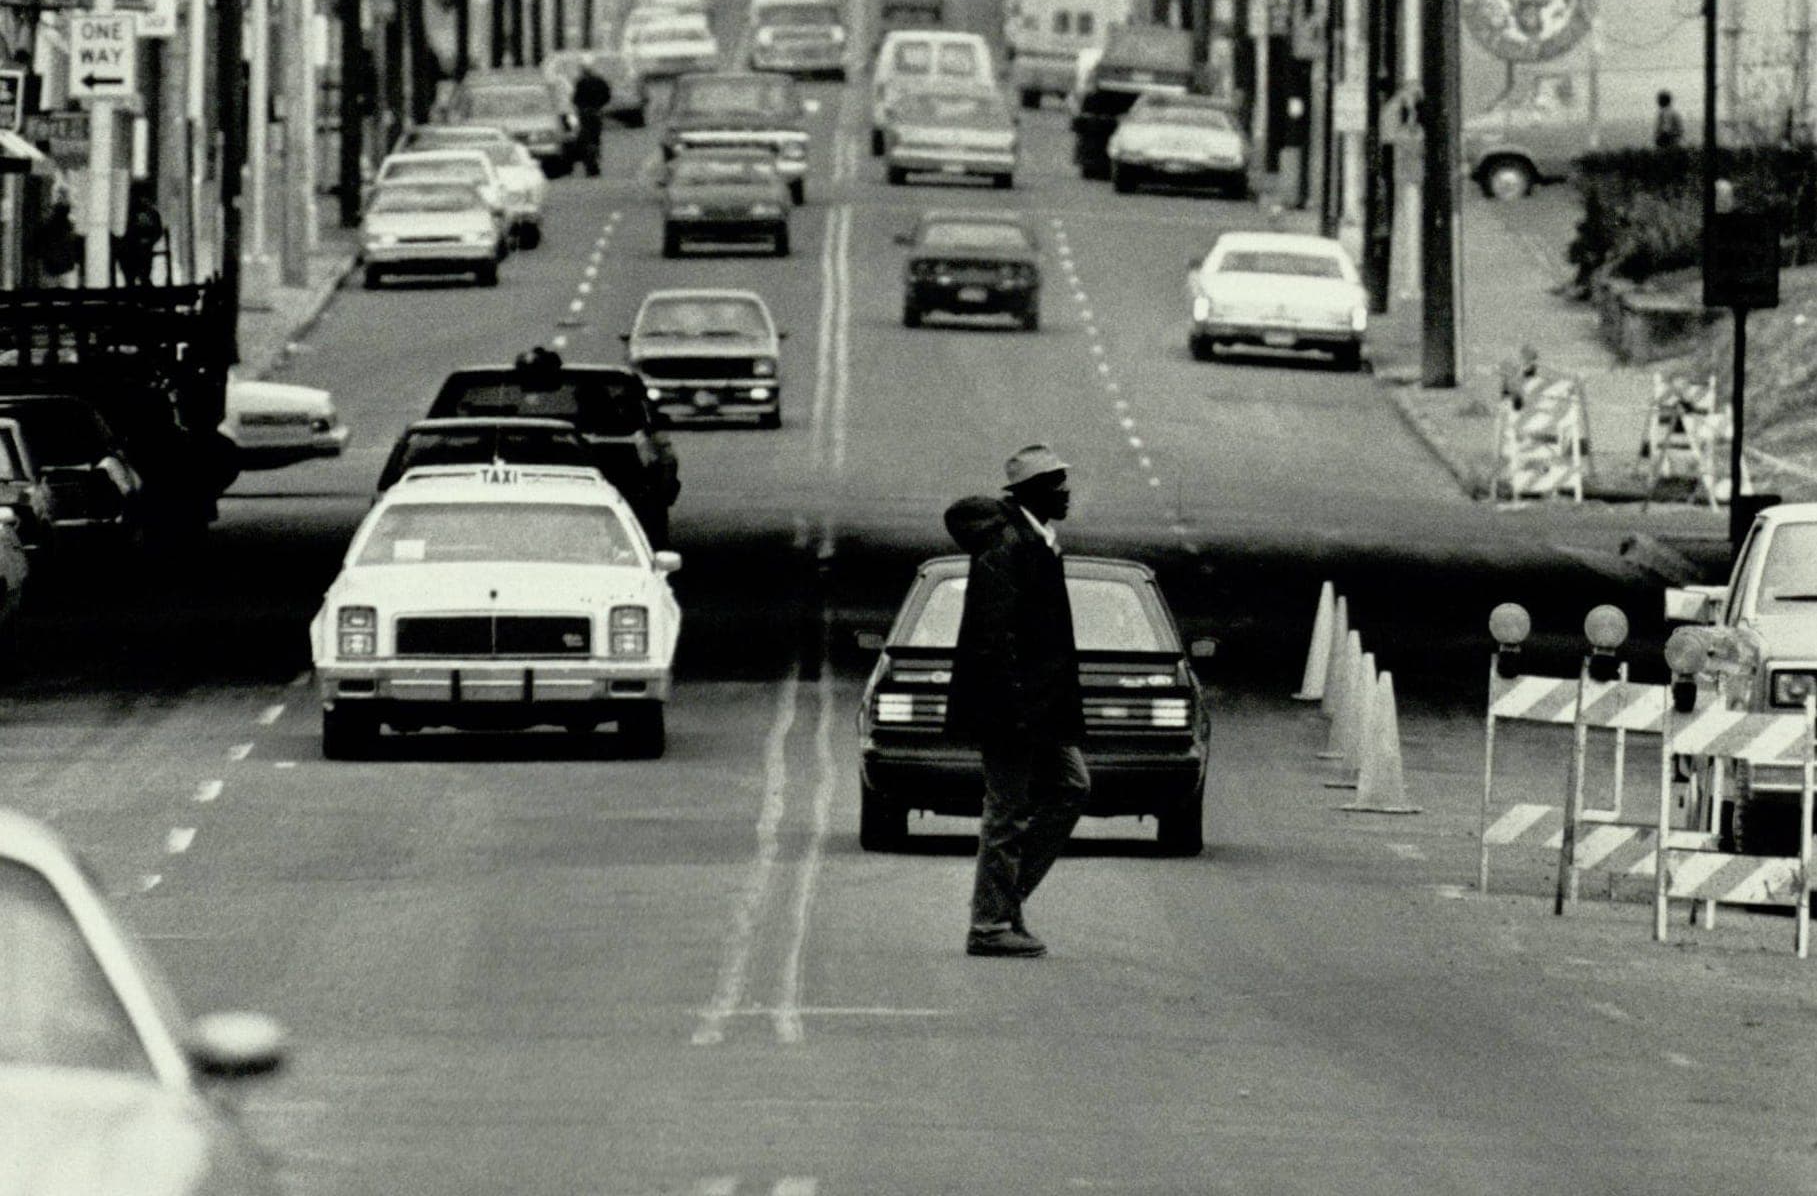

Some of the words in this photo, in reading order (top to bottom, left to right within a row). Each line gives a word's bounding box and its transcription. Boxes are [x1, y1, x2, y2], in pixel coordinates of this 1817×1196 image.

[81, 22, 123, 41] ONE
[80, 47, 124, 64] WAY
[480, 469, 518, 484] TAXI
